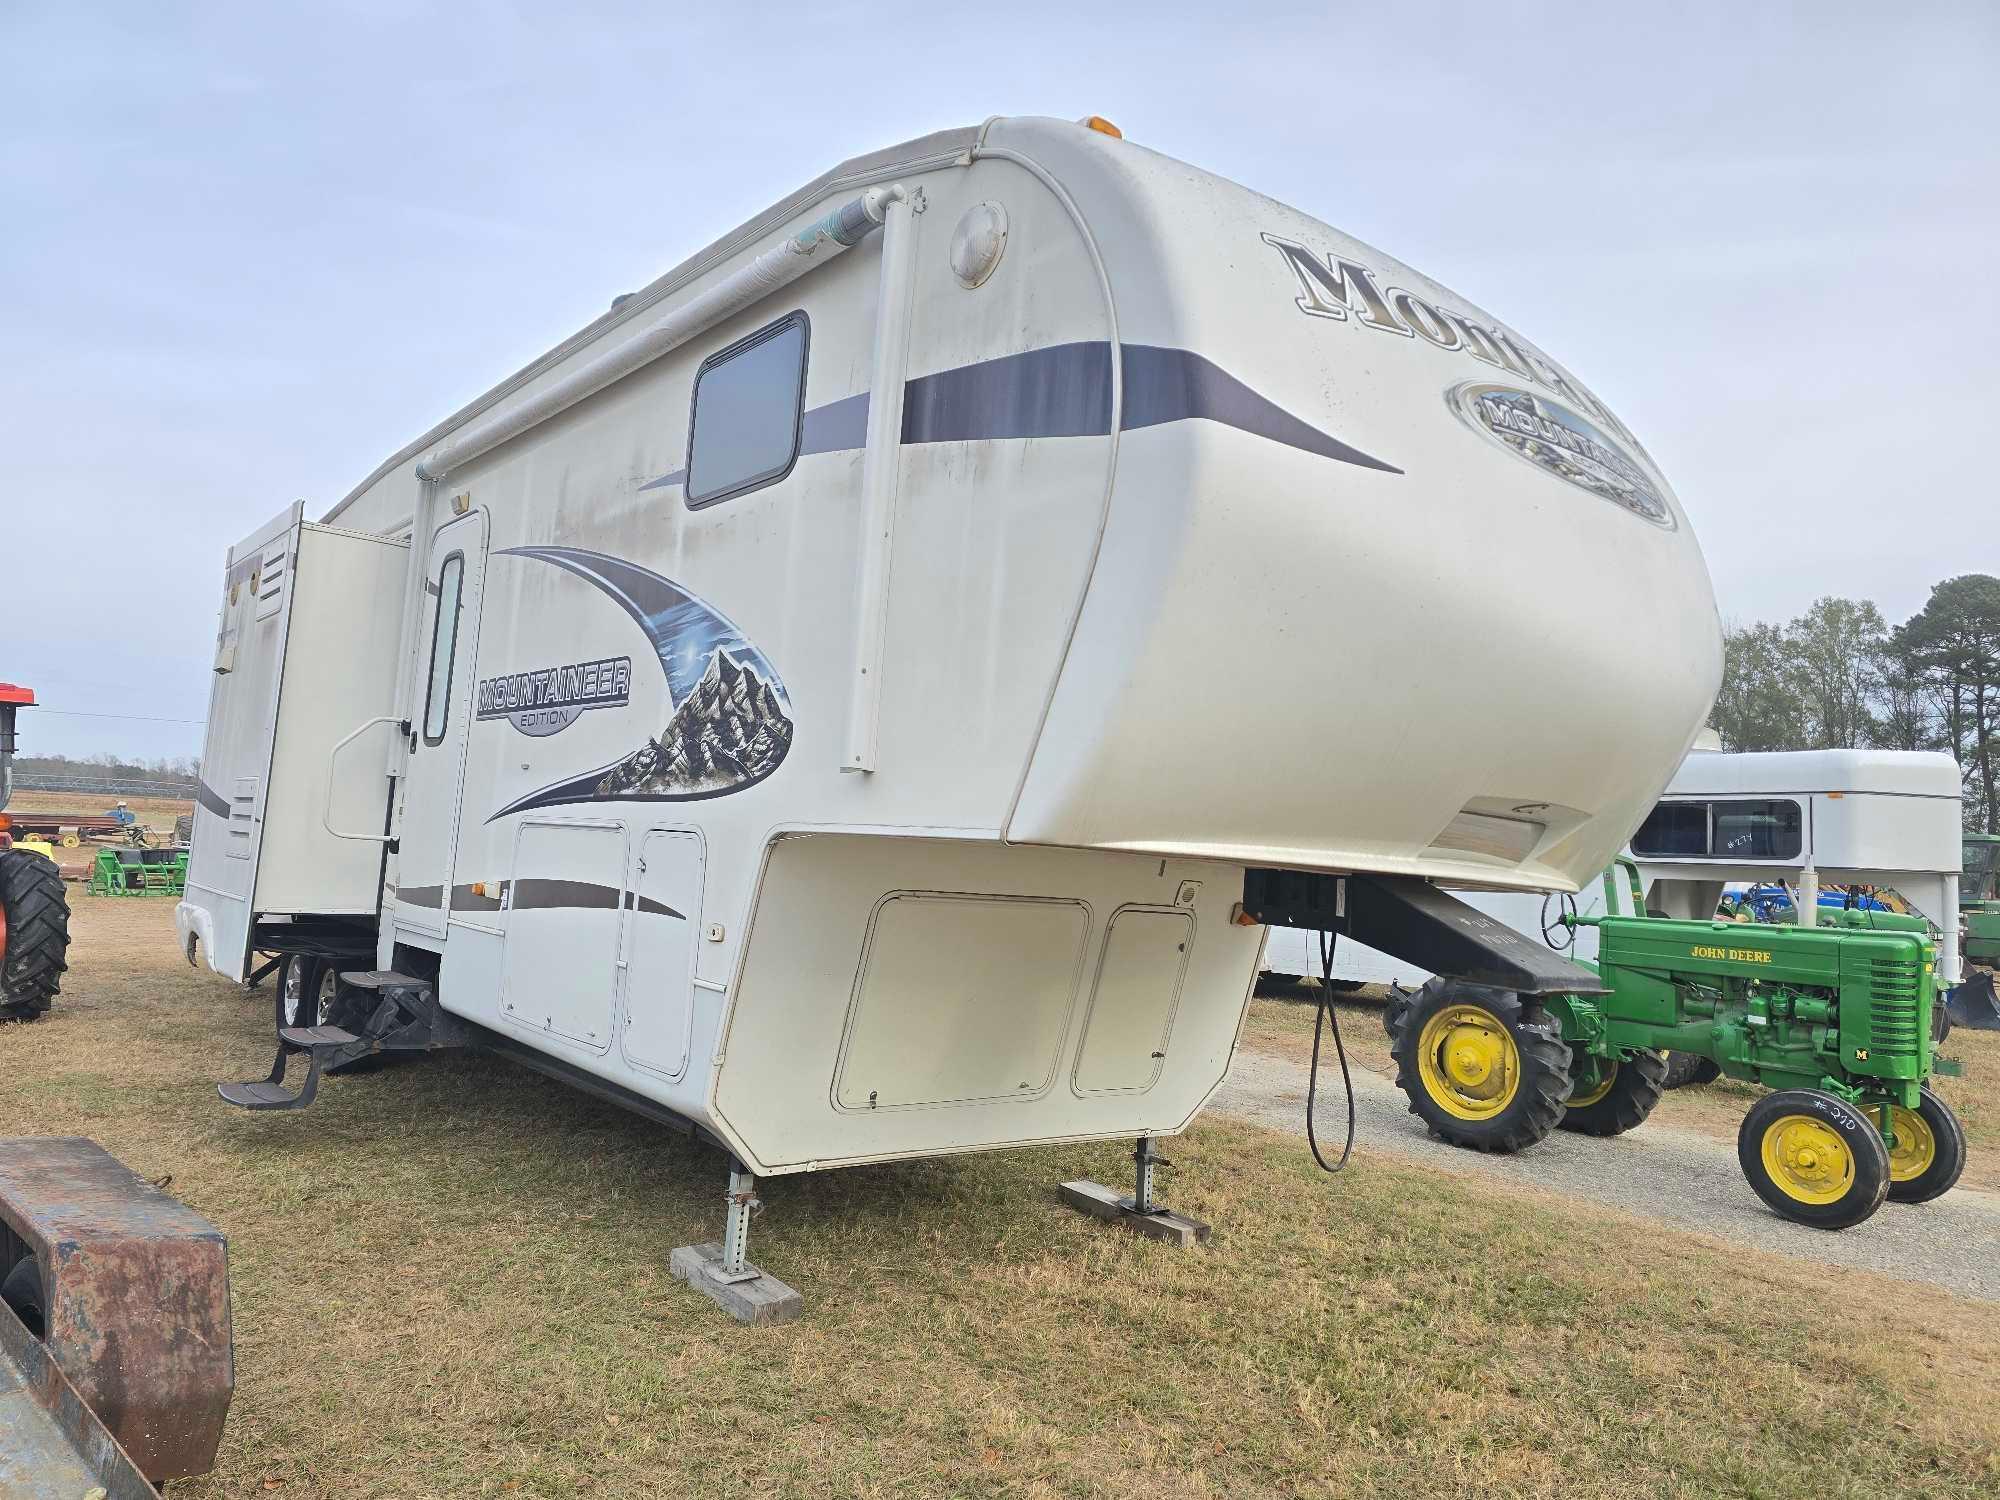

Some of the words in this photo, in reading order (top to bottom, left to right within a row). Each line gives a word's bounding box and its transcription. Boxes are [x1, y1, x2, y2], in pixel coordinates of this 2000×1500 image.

[478, 659, 631, 711] MOUNTAINEER
[520, 709, 569, 727] EDITION
[1691, 946, 1726, 960] JOHN
[1729, 949, 1772, 963] DEERE
[1855, 1049, 1868, 1060] M
